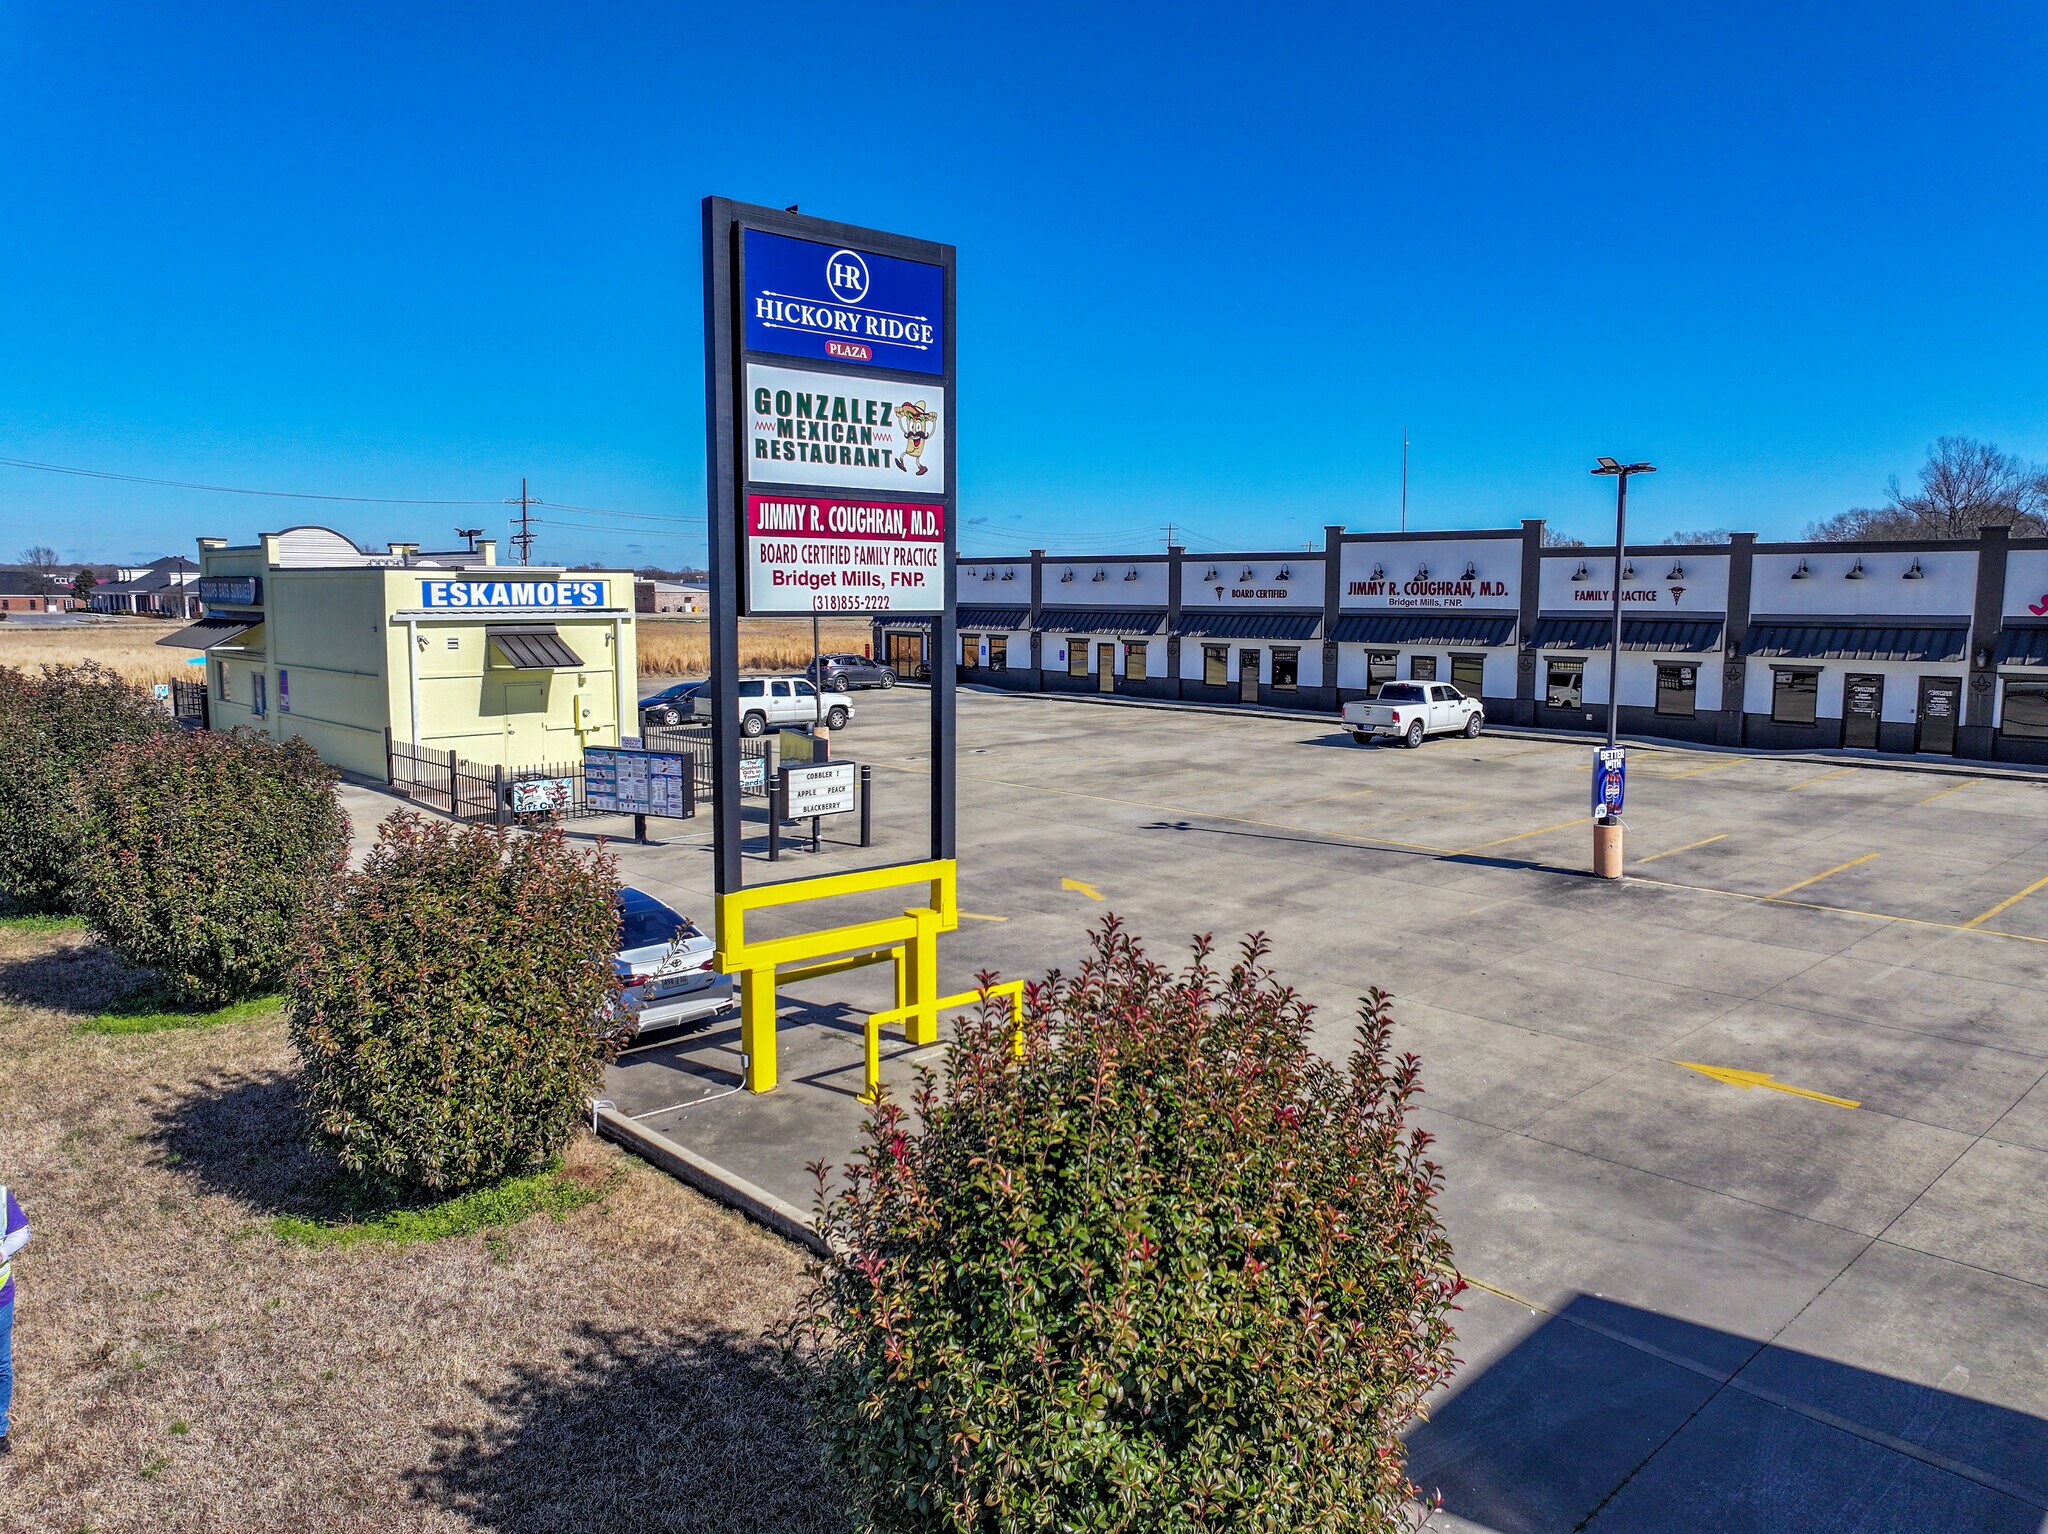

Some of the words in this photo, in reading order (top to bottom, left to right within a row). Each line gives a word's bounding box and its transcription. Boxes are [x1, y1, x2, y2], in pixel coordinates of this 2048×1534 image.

[755, 297, 861, 333] HICKORY
[865, 315, 934, 344] RIDGE
[829, 343, 868, 359] PLAZA
[754, 387, 893, 427] GONZALEZ
[776, 417, 873, 446] MEXICAN
[754, 437, 893, 468] RESTAURANT
[757, 502, 807, 531] JIMMY
[810, 504, 825, 532] R.
[828, 505, 907, 539] COUGHRAN,
[910, 510, 939, 537] M.D.
[760, 543, 798, 564] BOARD
[801, 544, 851, 565] CERTIFIED
[854, 545, 891, 566] FAMILY
[893, 547, 938, 567] PRACTICE
[772, 569, 837, 590] Bridget
[841, 570, 886, 590] Mills,
[890, 571, 926, 587] FNP.
[430, 582, 598, 606] ESKAMOE'S
[1231, 589, 1255, 598] BOARD
[1255, 589, 1288, 599] CERTIFIED
[1347, 581, 1386, 596] JIMMY
[1388, 582, 1401, 596] R.
[1403, 581, 1476, 599] COUGHRAN,
[1479, 581, 1509, 597] M.D.
[1574, 590, 1609, 601] FAMILY
[1612, 590, 1657, 602] RACTICE
[812, 595, 890, 612] (318)855-2222
[1388, 598, 1418, 607] Bridget
[1419, 598, 1442, 607] Mills,
[1443, 599, 1463, 607] FNP.
[1600, 748, 1625, 761] BETTER
[1605, 758, 1622, 770] WITH
[806, 771, 833, 780] COBBLER
[797, 788, 817, 798] APPLE
[827, 785, 846, 794] PEACH
[803, 801, 841, 813] BLACKBERRY
